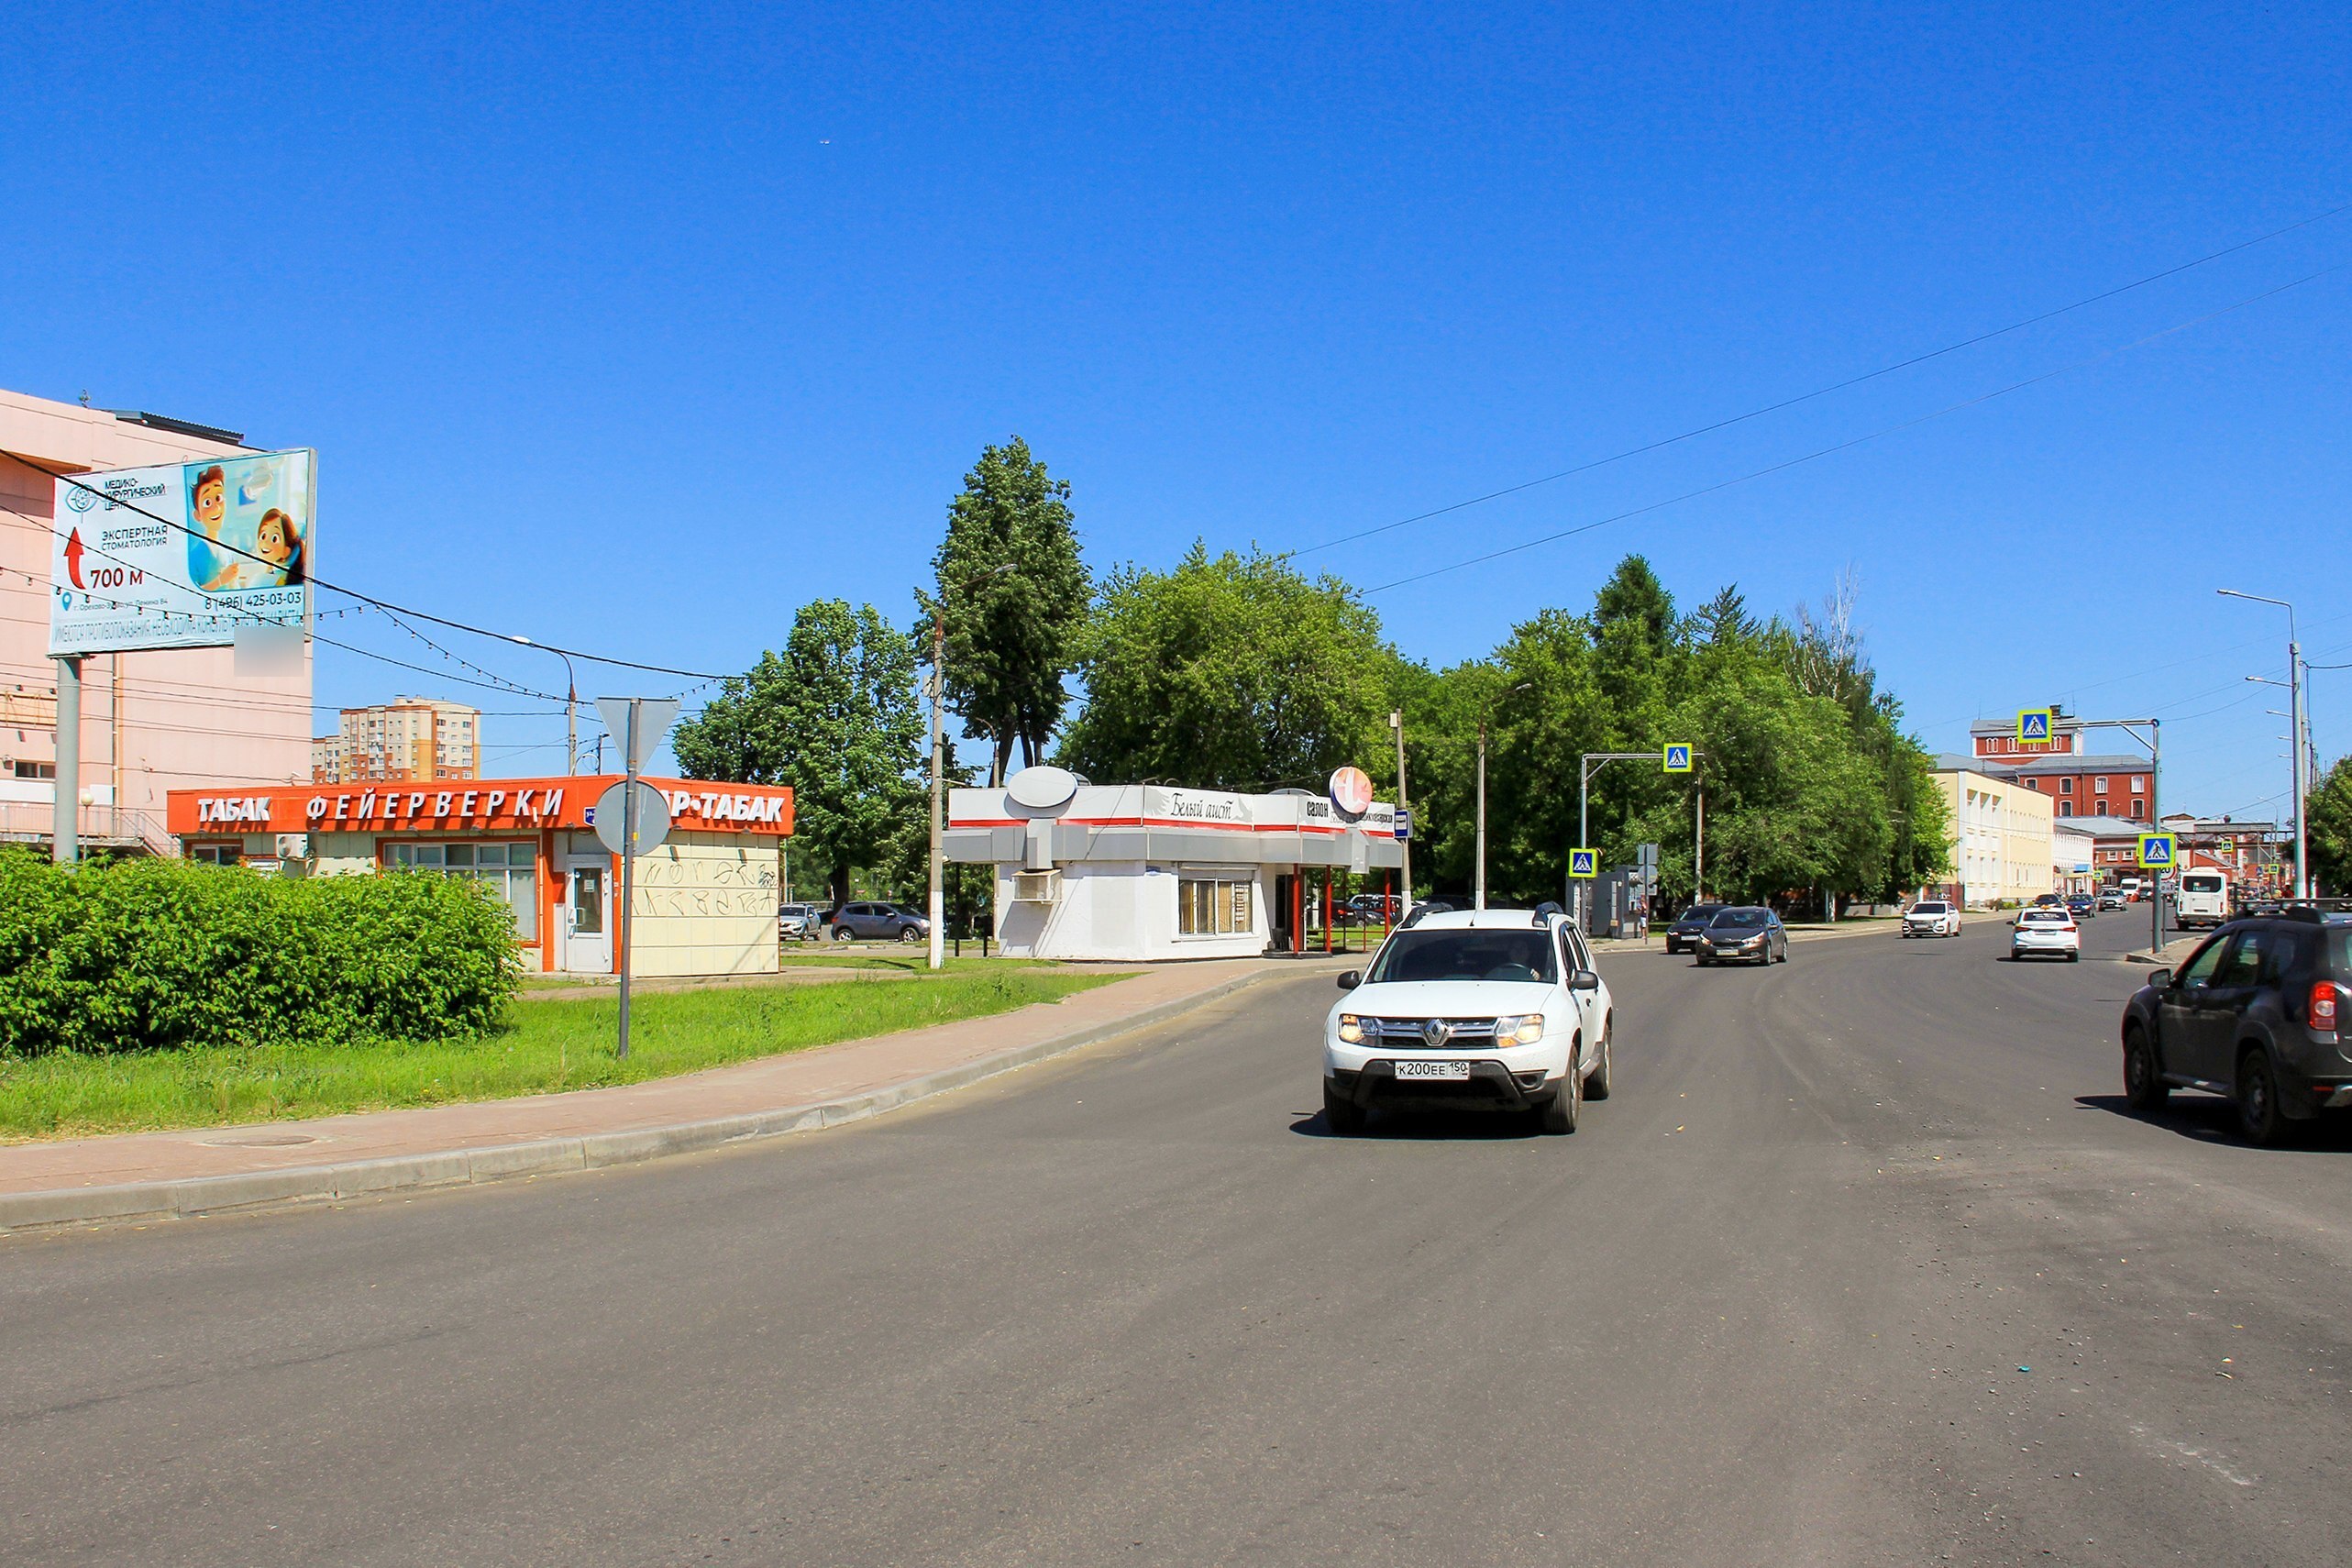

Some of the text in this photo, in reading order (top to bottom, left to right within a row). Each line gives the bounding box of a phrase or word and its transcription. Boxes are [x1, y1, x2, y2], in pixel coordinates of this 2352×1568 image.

[105, 478, 138, 490] МЕДИКО-
[102, 525, 168, 541] ЭКСПЕРТНАЯ
[101, 537, 168, 551] СТОМАТОЛОГИЯ
[90, 568, 124, 589] 700
[204, 591, 302, 612] 8 (496) 425-03-03
[198, 788, 563, 823] ТАБАК ФЕЙЕРВЕРКИ
[1170, 792, 1233, 819] Белый аист
[1449, 1062, 1467, 1072] 150
